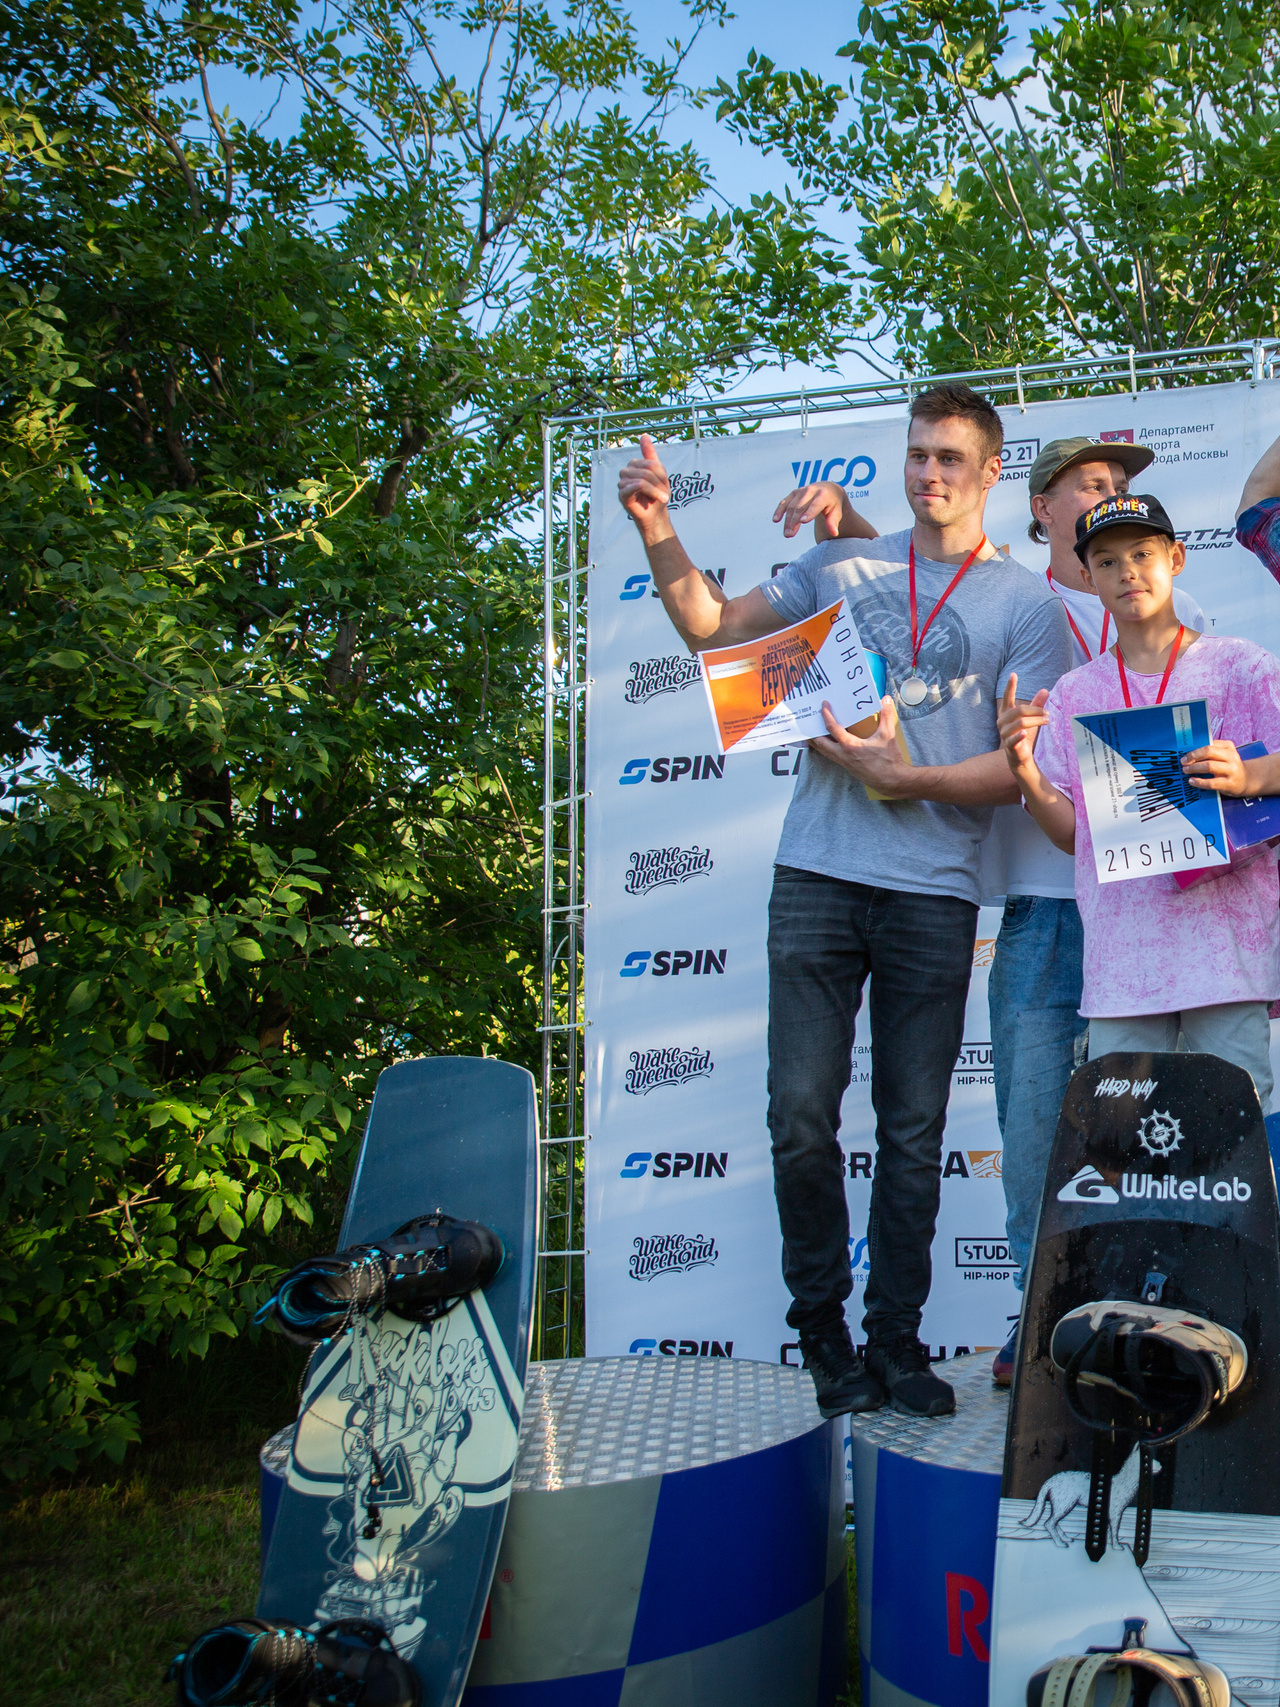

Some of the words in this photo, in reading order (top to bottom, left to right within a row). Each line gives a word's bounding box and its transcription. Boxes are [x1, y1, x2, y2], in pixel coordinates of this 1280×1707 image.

[1139, 423, 1215, 440] Департамент
[1016, 446, 1032, 461] 21
[1152, 453, 1181, 466] рода
[1182, 449, 1229, 462] Москвы
[1084, 497, 1149, 531] THRASHER
[1175, 527, 1237, 542] RTH
[761, 637, 813, 666] ЭЛЕКТРОННЫЙ
[761, 652, 832, 708] СЕРТИФИКАТ
[650, 754, 726, 783] SPIN
[1129, 749, 1185, 823] СЕРТИФИКАТ
[651, 949, 728, 976] SPIN
[957, 1076, 995, 1085] HIP-HO
[1095, 1078, 1131, 1098] HARD
[1130, 1078, 1159, 1100] WAY
[652, 1152, 728, 1178] SPIN
[1121, 1172, 1252, 1202] WhiteLab
[963, 1244, 1013, 1260] STUDI
[963, 1271, 1010, 1280] HIP-HOP
[347, 1312, 489, 1388] Reckless
